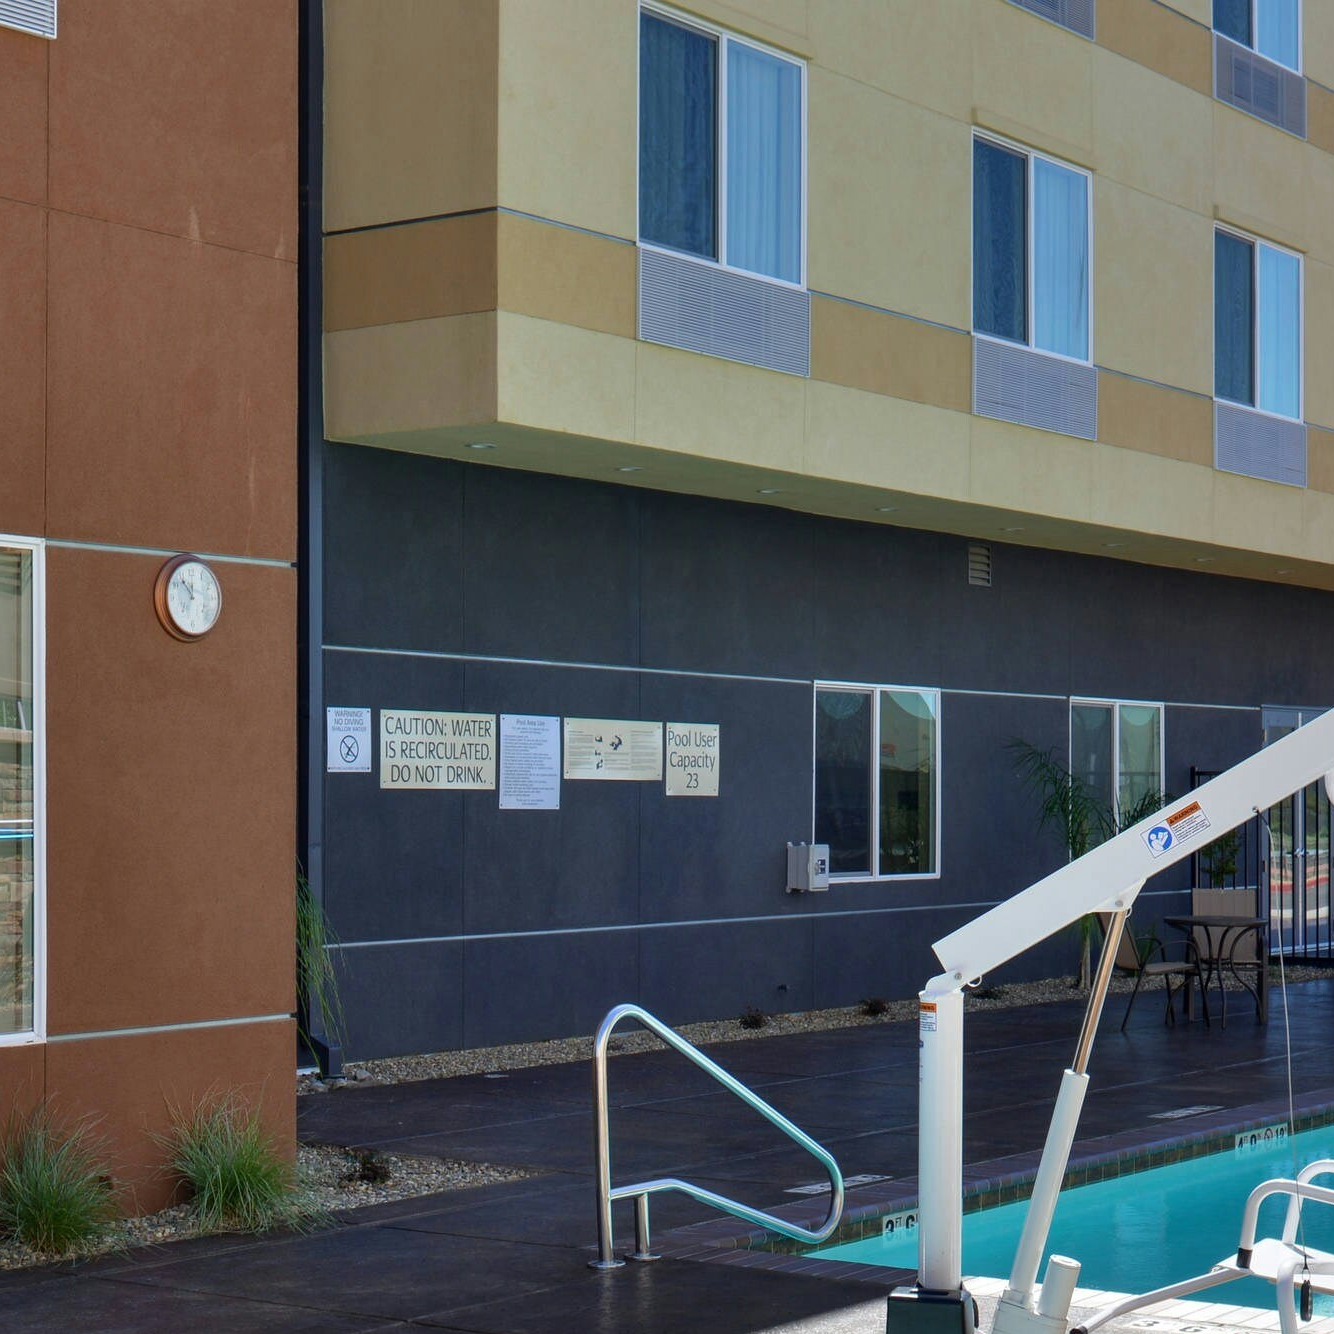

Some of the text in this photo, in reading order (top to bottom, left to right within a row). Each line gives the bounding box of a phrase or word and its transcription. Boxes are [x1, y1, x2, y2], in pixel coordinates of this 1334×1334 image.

[385, 716, 491, 738] CAUTION: WATER
[668, 730, 717, 748] Pool User
[385, 741, 491, 760] IS RECIRCULATED.
[670, 751, 715, 772] Capacity
[391, 764, 487, 784] DO NOT DRINK.
[686, 772, 699, 788] 23
